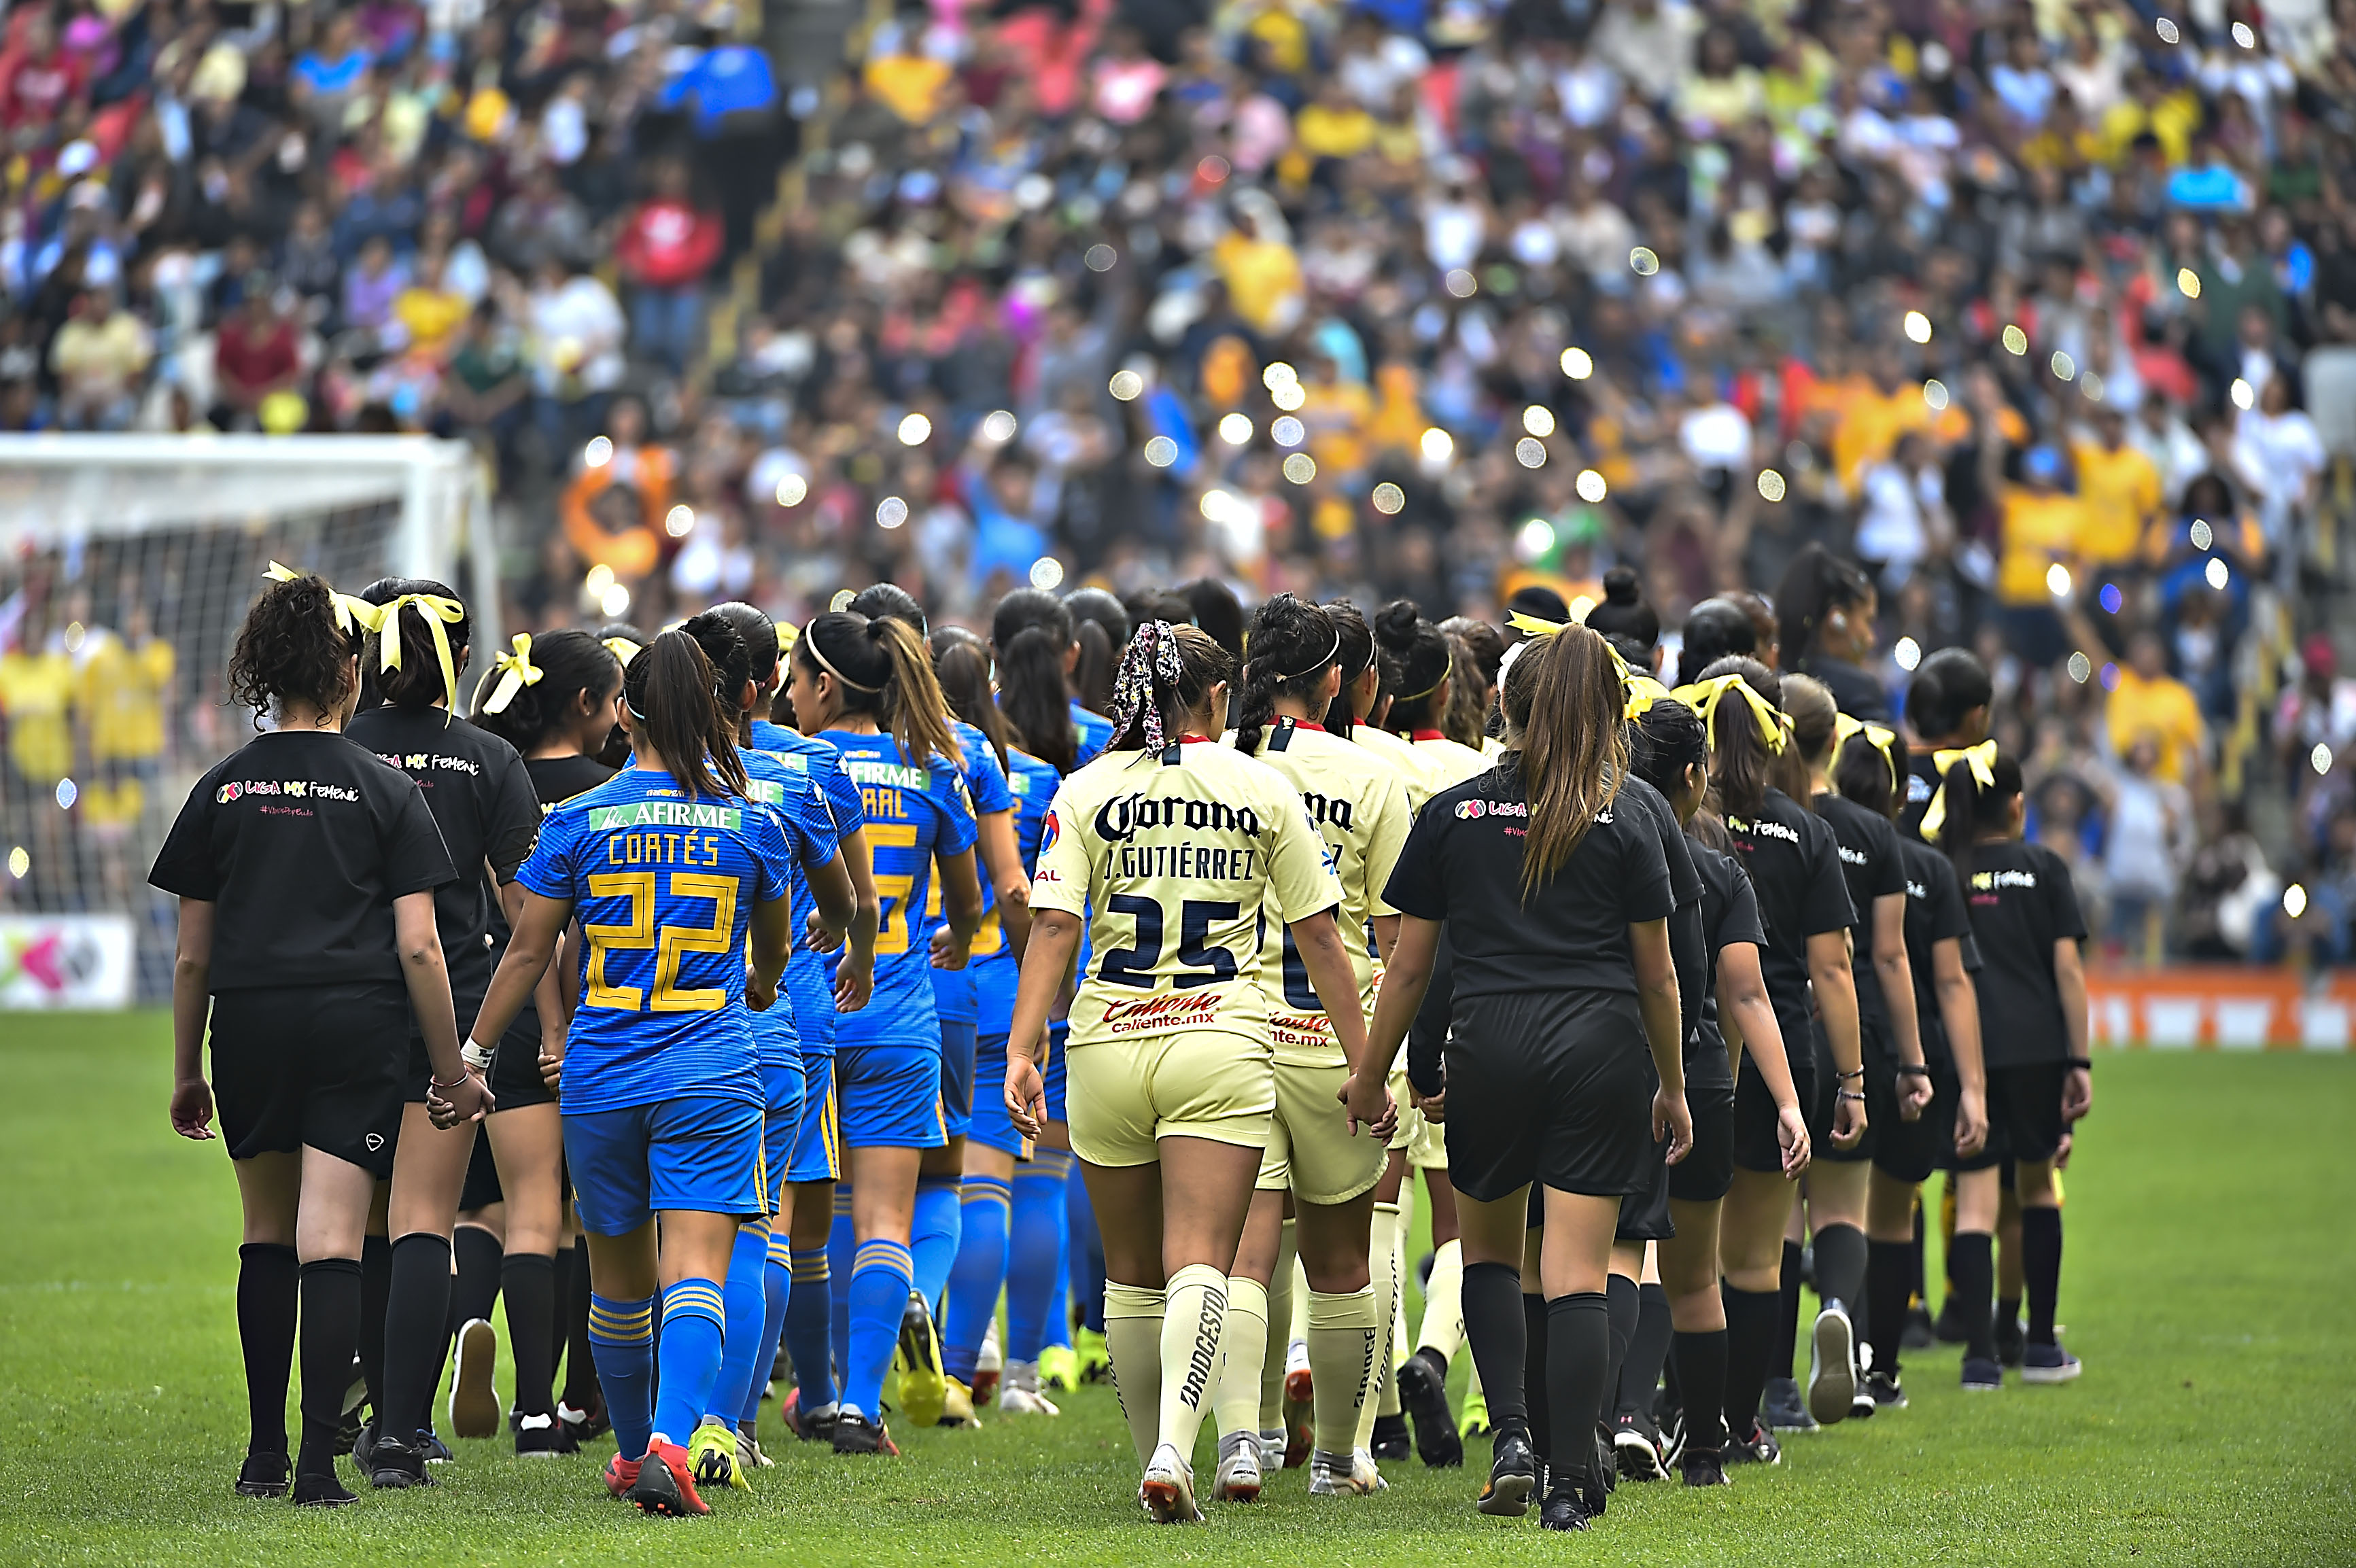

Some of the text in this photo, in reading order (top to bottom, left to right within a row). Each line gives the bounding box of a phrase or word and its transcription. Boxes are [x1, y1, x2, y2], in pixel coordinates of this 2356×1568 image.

[406, 754, 428, 769] MX
[850, 762, 922, 789] FIRME
[245, 780, 281, 795] LIGA
[284, 781, 307, 798] MX
[863, 788, 907, 818] RAL
[634, 802, 731, 829] AFIRME
[1094, 792, 1261, 843] Corona
[1489, 801, 1527, 816] LIGA
[609, 829, 718, 866] CORTÉS
[1104, 841, 1255, 880] J.GUTIÉRREZ
[1035, 870, 1060, 881] AL
[585, 872, 740, 1011] 22
[1097, 894, 1241, 988] 25
[1103, 992, 1222, 1023] Caliente
[1112, 1013, 1214, 1032] caliente.mx
[1270, 1031, 1328, 1047] nte.mx
[1180, 1290, 1224, 1412] BRIDGESTO
[1354, 1327, 1376, 1408] BRIDGE
